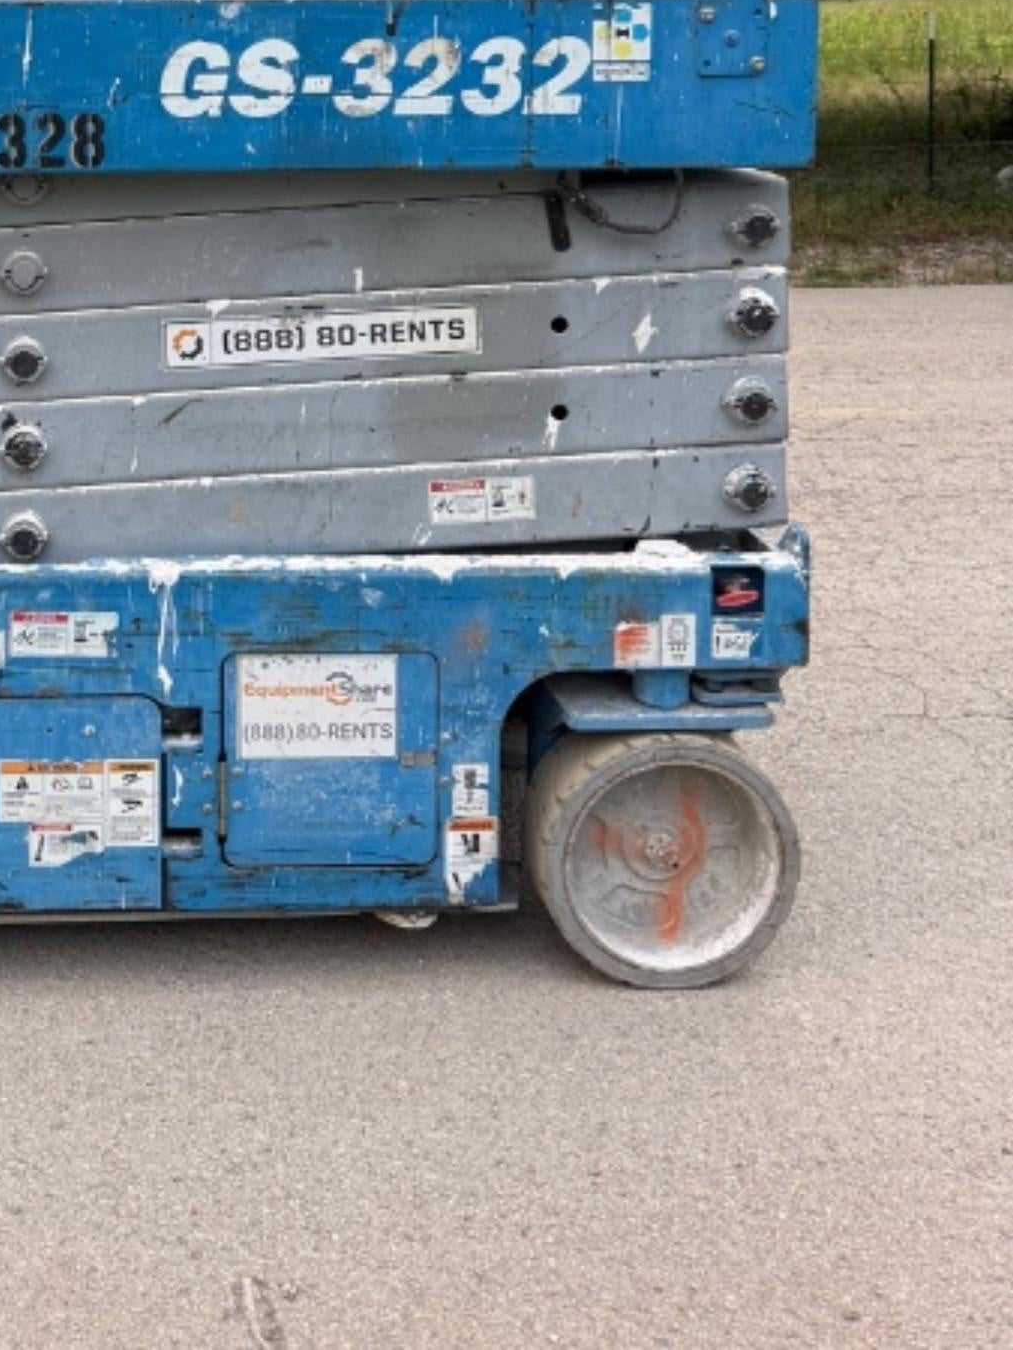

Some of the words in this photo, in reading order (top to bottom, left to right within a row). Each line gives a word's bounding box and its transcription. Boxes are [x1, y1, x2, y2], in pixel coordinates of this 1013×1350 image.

[160, 37, 589, 117] GS-3232
[223, 326, 305, 354] (888)
[316, 318, 465, 346] 80-RENTS
